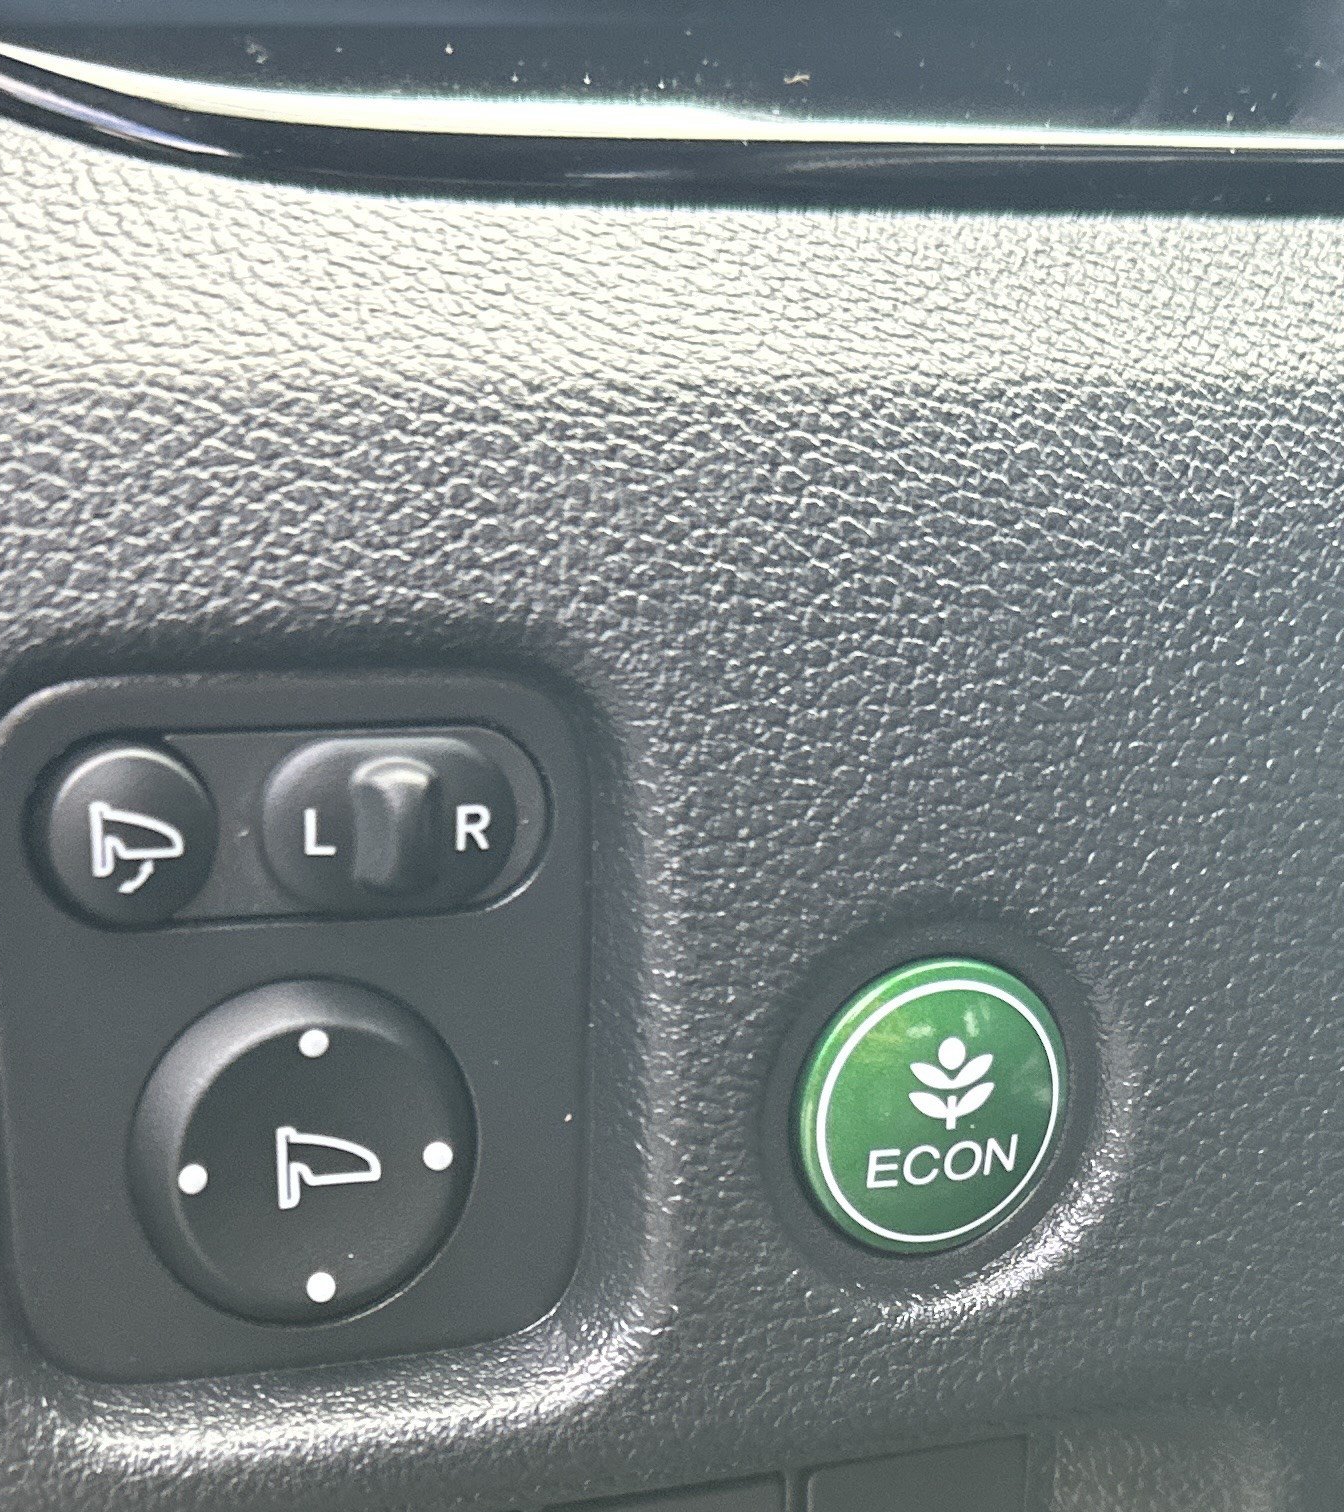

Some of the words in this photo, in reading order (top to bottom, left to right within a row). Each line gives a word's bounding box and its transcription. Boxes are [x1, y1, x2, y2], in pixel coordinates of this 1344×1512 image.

[303, 807, 337, 856] L
[455, 804, 491, 851] R
[866, 1133, 1018, 1189] ECON
